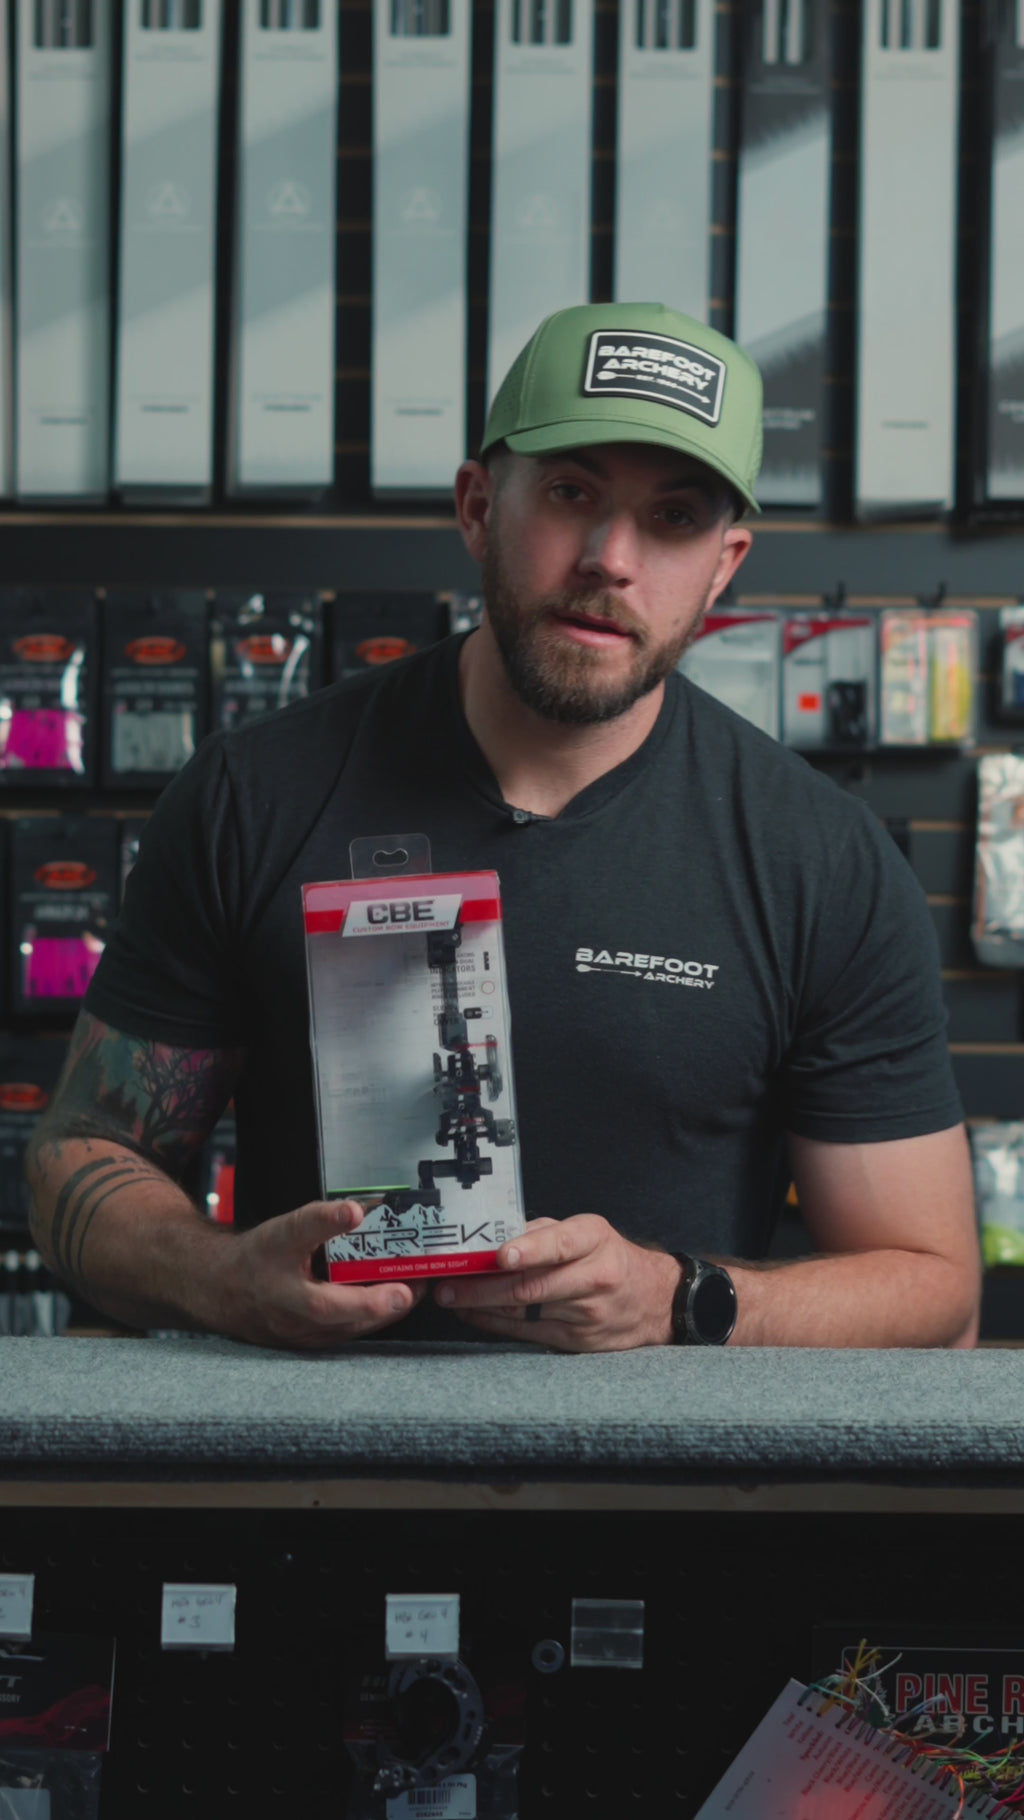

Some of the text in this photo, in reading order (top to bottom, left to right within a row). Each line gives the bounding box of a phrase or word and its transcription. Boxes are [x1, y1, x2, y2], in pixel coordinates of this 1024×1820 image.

[598, 345, 716, 380] BAREFOOT
[603, 358, 709, 390] ARCHERY
[367, 899, 436, 924] CBE
[353, 921, 450, 934] CUSTOM BOW EQUIPMENT
[575, 947, 719, 979] BAREFOOT
[643, 971, 715, 990] ARCHERY
[346, 1222, 493, 1253] TREK
[379, 1260, 469, 1274] CONTAINS ONE BOW SIGHT
[895, 1672, 989, 1715] PINE
